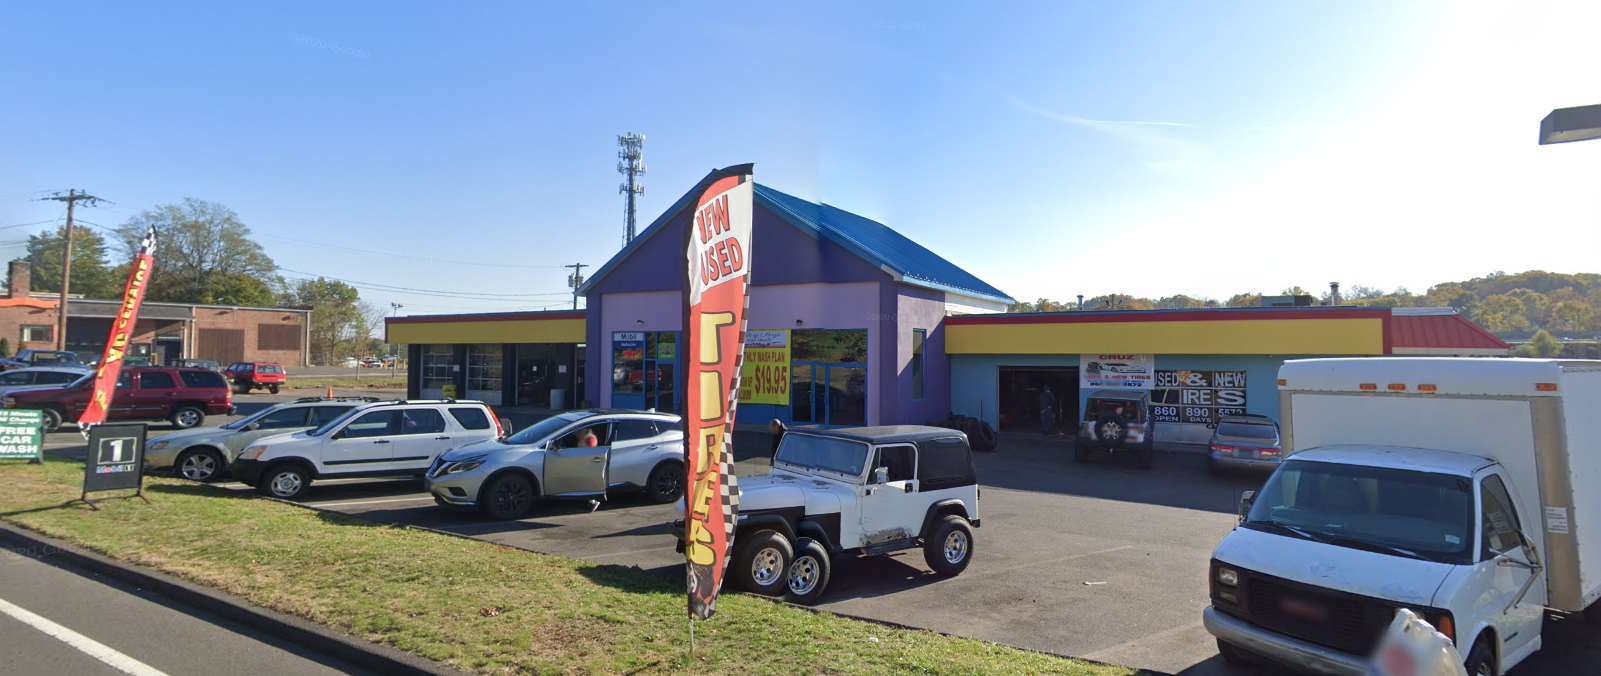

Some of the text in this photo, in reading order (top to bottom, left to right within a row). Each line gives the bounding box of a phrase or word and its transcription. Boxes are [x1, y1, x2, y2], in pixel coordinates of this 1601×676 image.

[696, 193, 731, 245] NEW
[700, 236, 744, 286] USED
[772, 351, 786, 363] PLAN
[755, 365, 787, 396] $19.95
[1185, 372, 1208, 387] &
[1215, 372, 1246, 388] NEW
[1182, 389, 1246, 406] IRES
[1154, 406, 1177, 416] 860
[1185, 407, 1209, 417] 890
[0, 427, 36, 435] FREE
[0, 435, 32, 444] CAR
[0, 444, 38, 454] WASH
[110, 440, 123, 461] 1
[96, 465, 124, 473] Mobil
